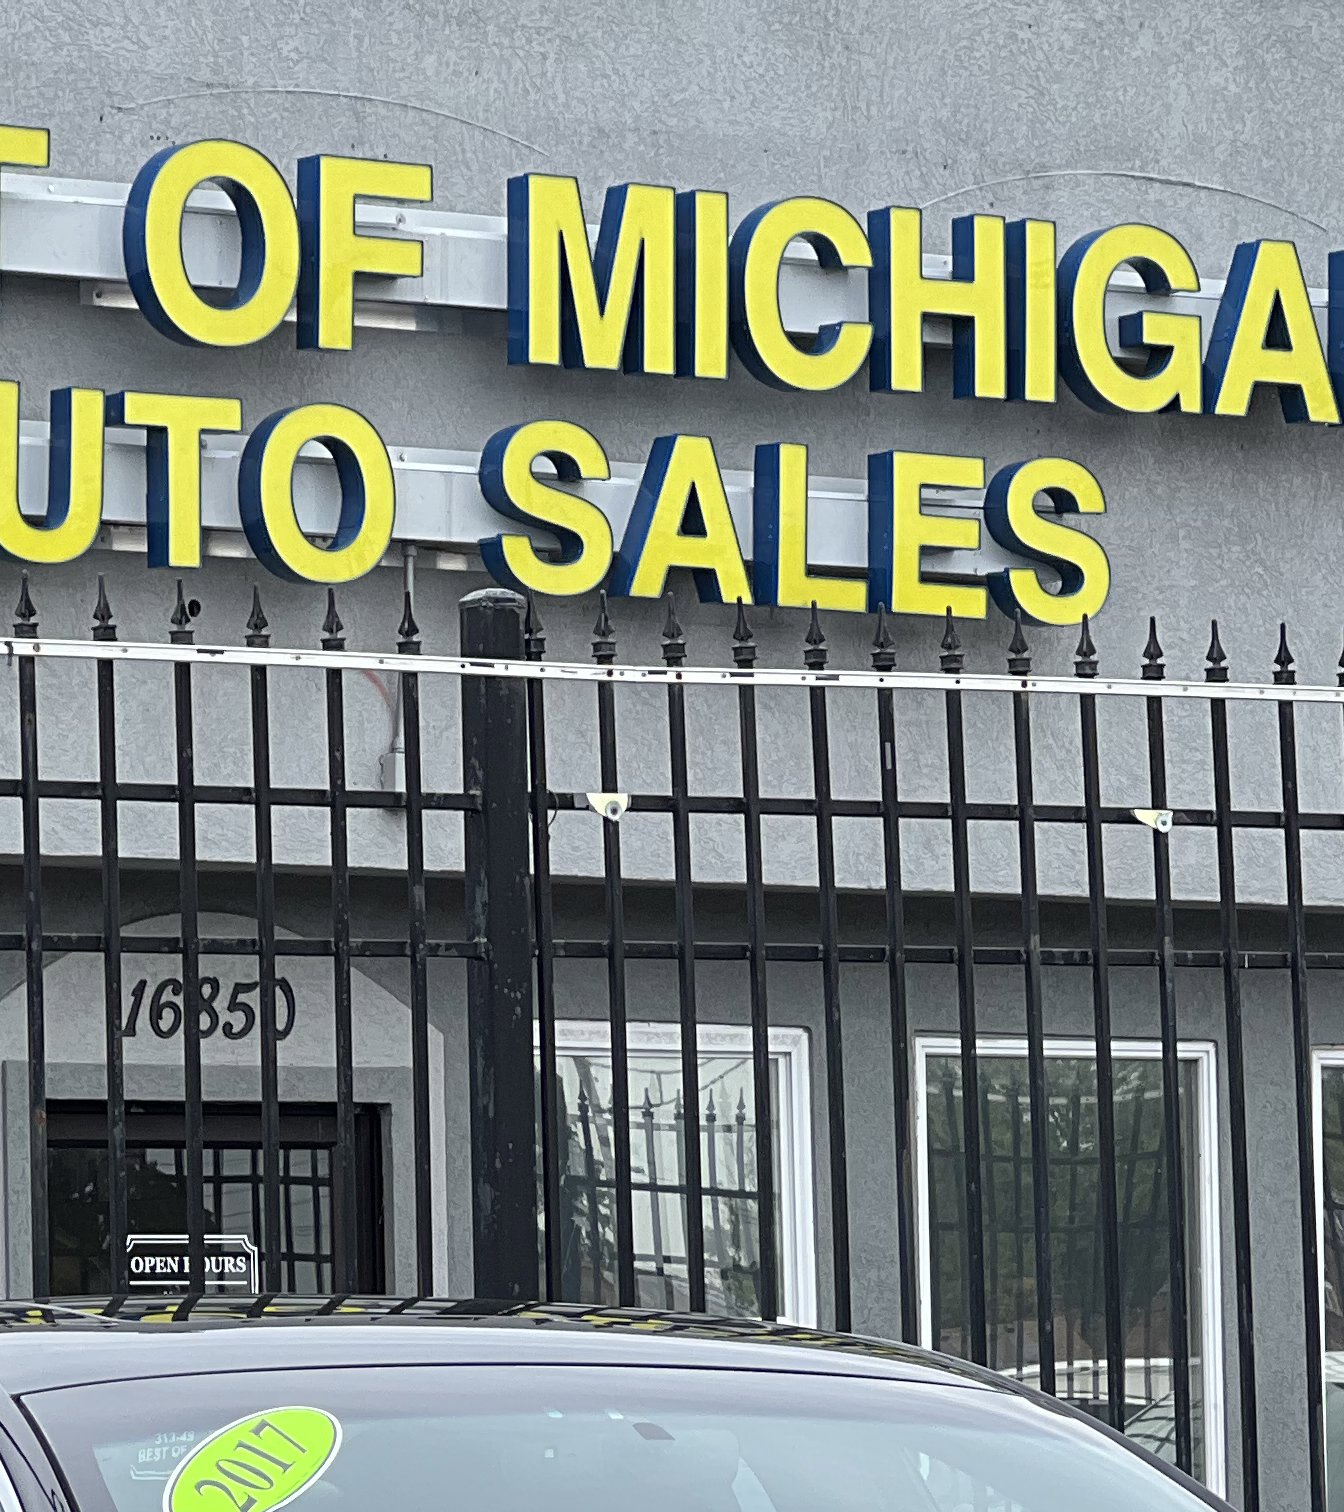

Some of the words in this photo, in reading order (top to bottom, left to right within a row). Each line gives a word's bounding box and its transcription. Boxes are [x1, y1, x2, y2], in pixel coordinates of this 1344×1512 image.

[122, 137, 434, 350] OF
[478, 419, 1110, 626] SALES
[122, 976, 295, 1041] 16850
[130, 1256, 178, 1273] OPEN
[138, 1446, 168, 1463] BEST
